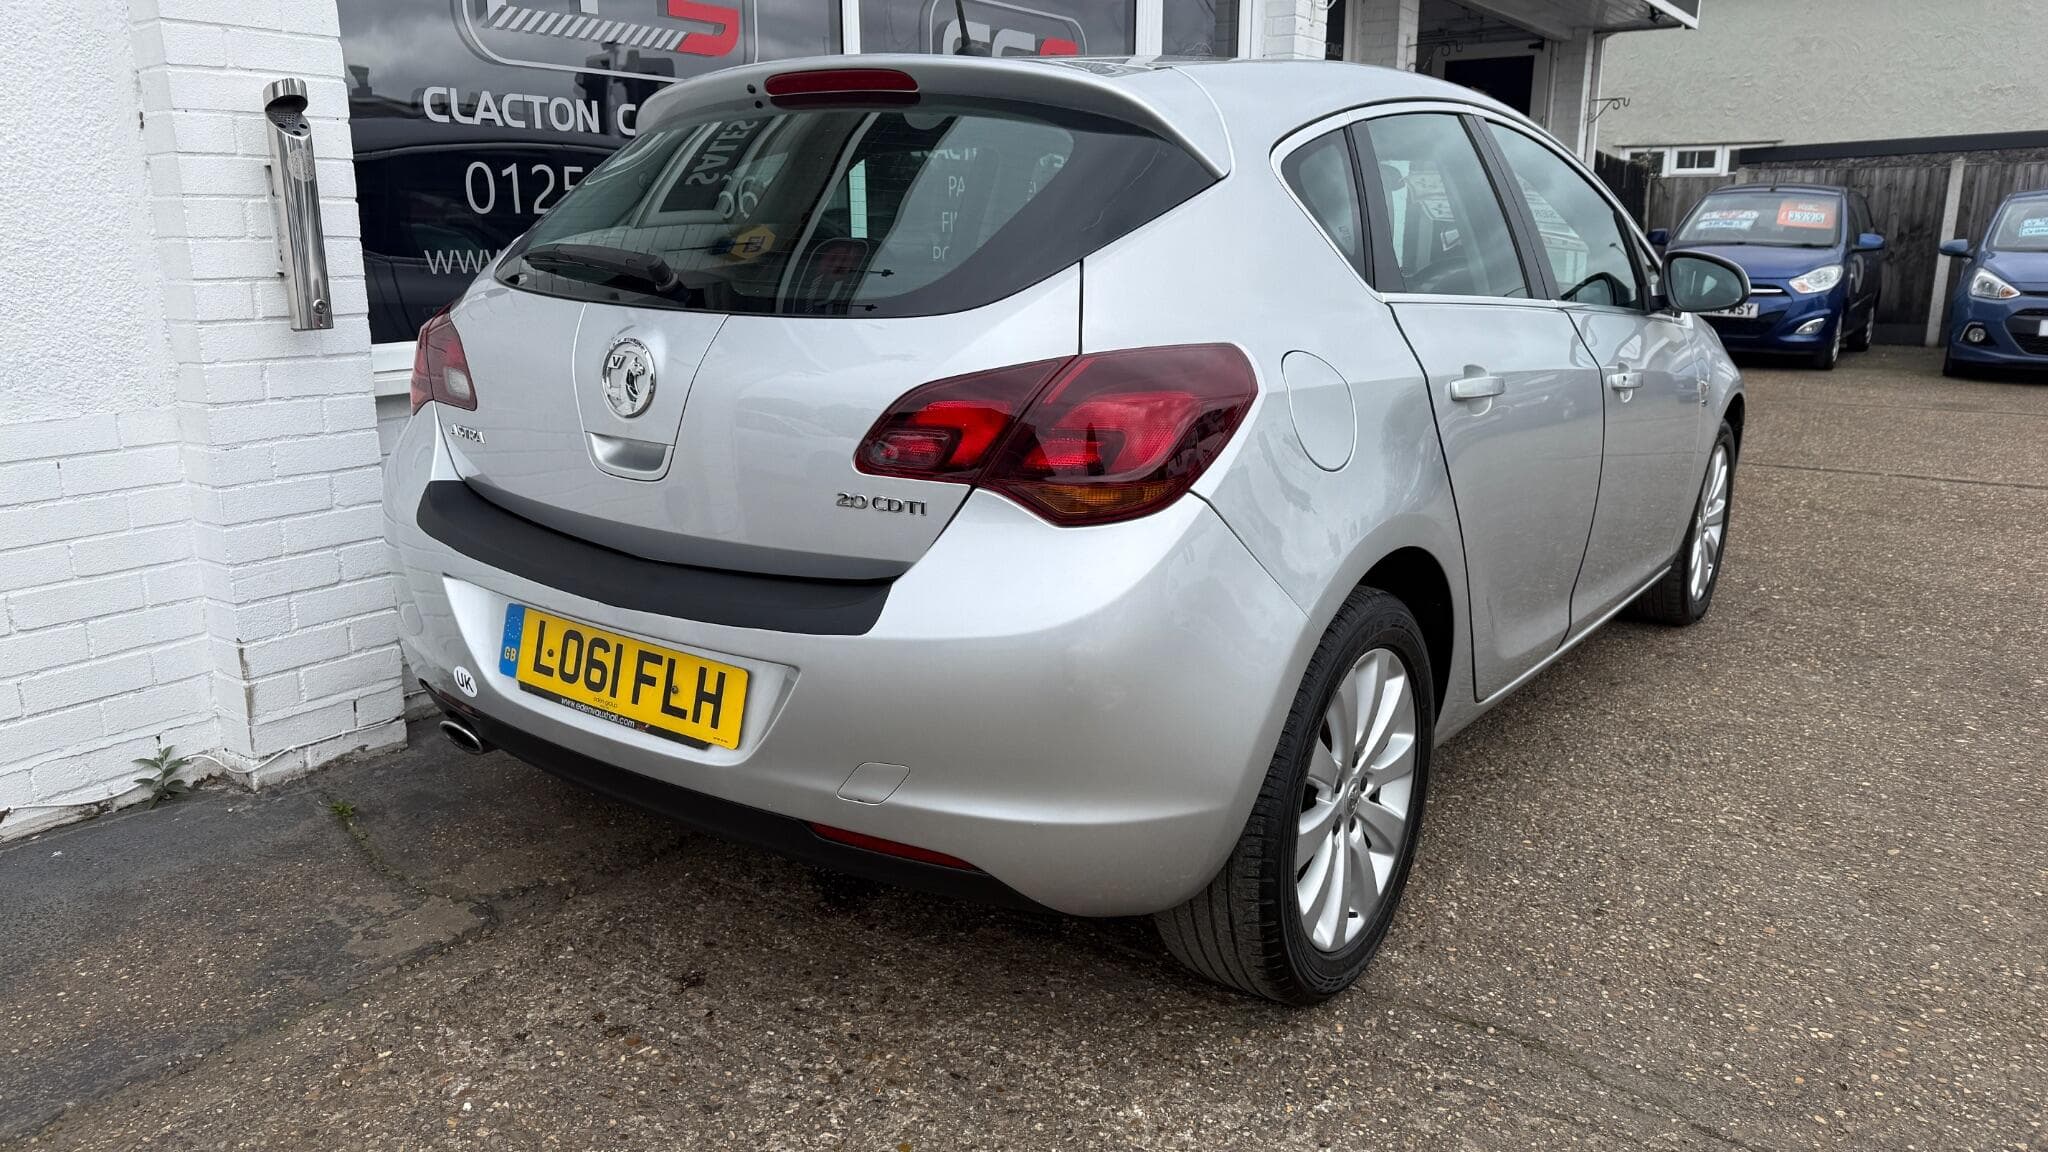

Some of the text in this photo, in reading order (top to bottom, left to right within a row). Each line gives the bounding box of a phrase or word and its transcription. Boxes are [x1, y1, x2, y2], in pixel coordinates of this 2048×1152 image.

[423, 86, 600, 134] CLACTON
[451, 423, 486, 445] ASTRA
[872, 495, 927, 516] CDTI
[504, 646, 516, 662] GB
[456, 670, 474, 693] UK
[533, 620, 725, 730] LO61 FLH
